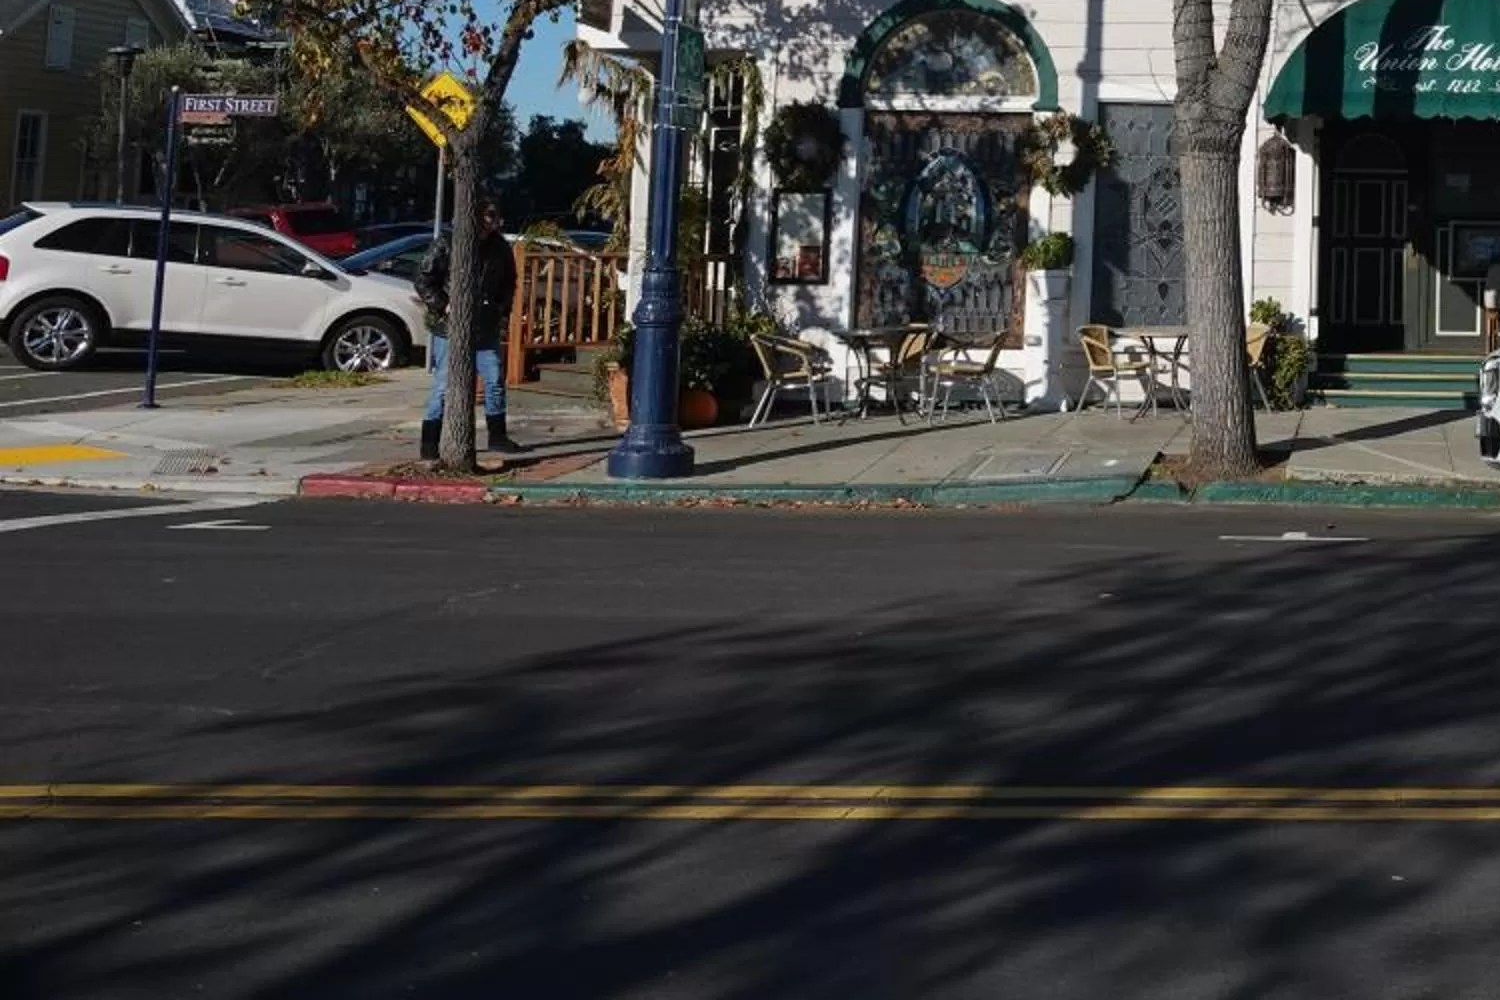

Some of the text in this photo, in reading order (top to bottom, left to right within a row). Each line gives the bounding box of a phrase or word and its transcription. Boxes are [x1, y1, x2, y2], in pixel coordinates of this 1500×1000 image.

[1407, 25, 1455, 51] The
[1353, 41, 1438, 71] Union
[185, 97, 273, 113] FIRST STREET
